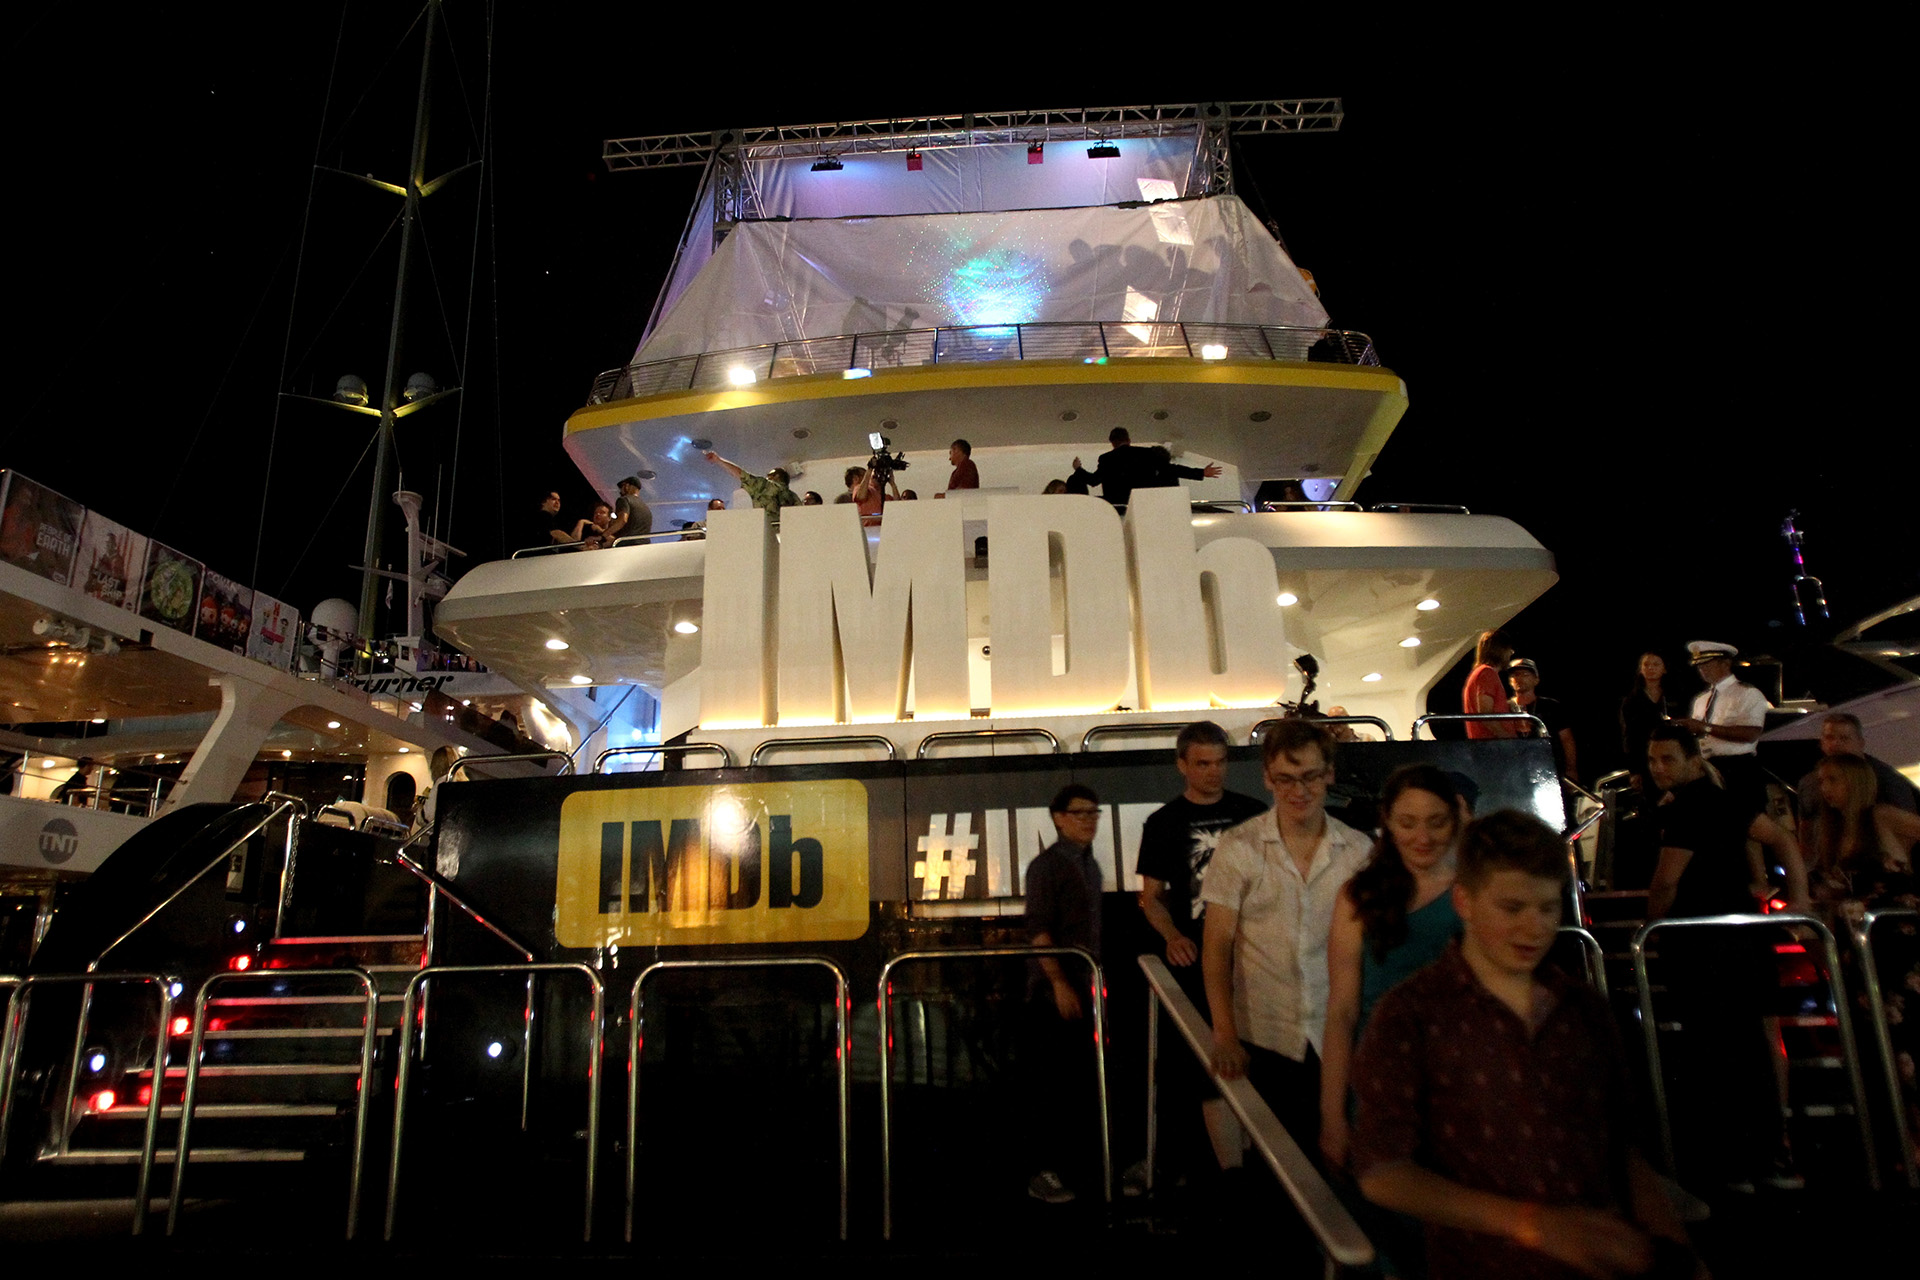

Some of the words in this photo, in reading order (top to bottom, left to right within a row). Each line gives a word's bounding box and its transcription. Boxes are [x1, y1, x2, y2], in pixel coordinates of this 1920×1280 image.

[36, 532, 71, 557] EARTH
[97, 574, 120, 589] LAST
[101, 586, 123, 600] SHIP
[699, 486, 1289, 730] IMDb
[598, 815, 824, 914] IMDb
